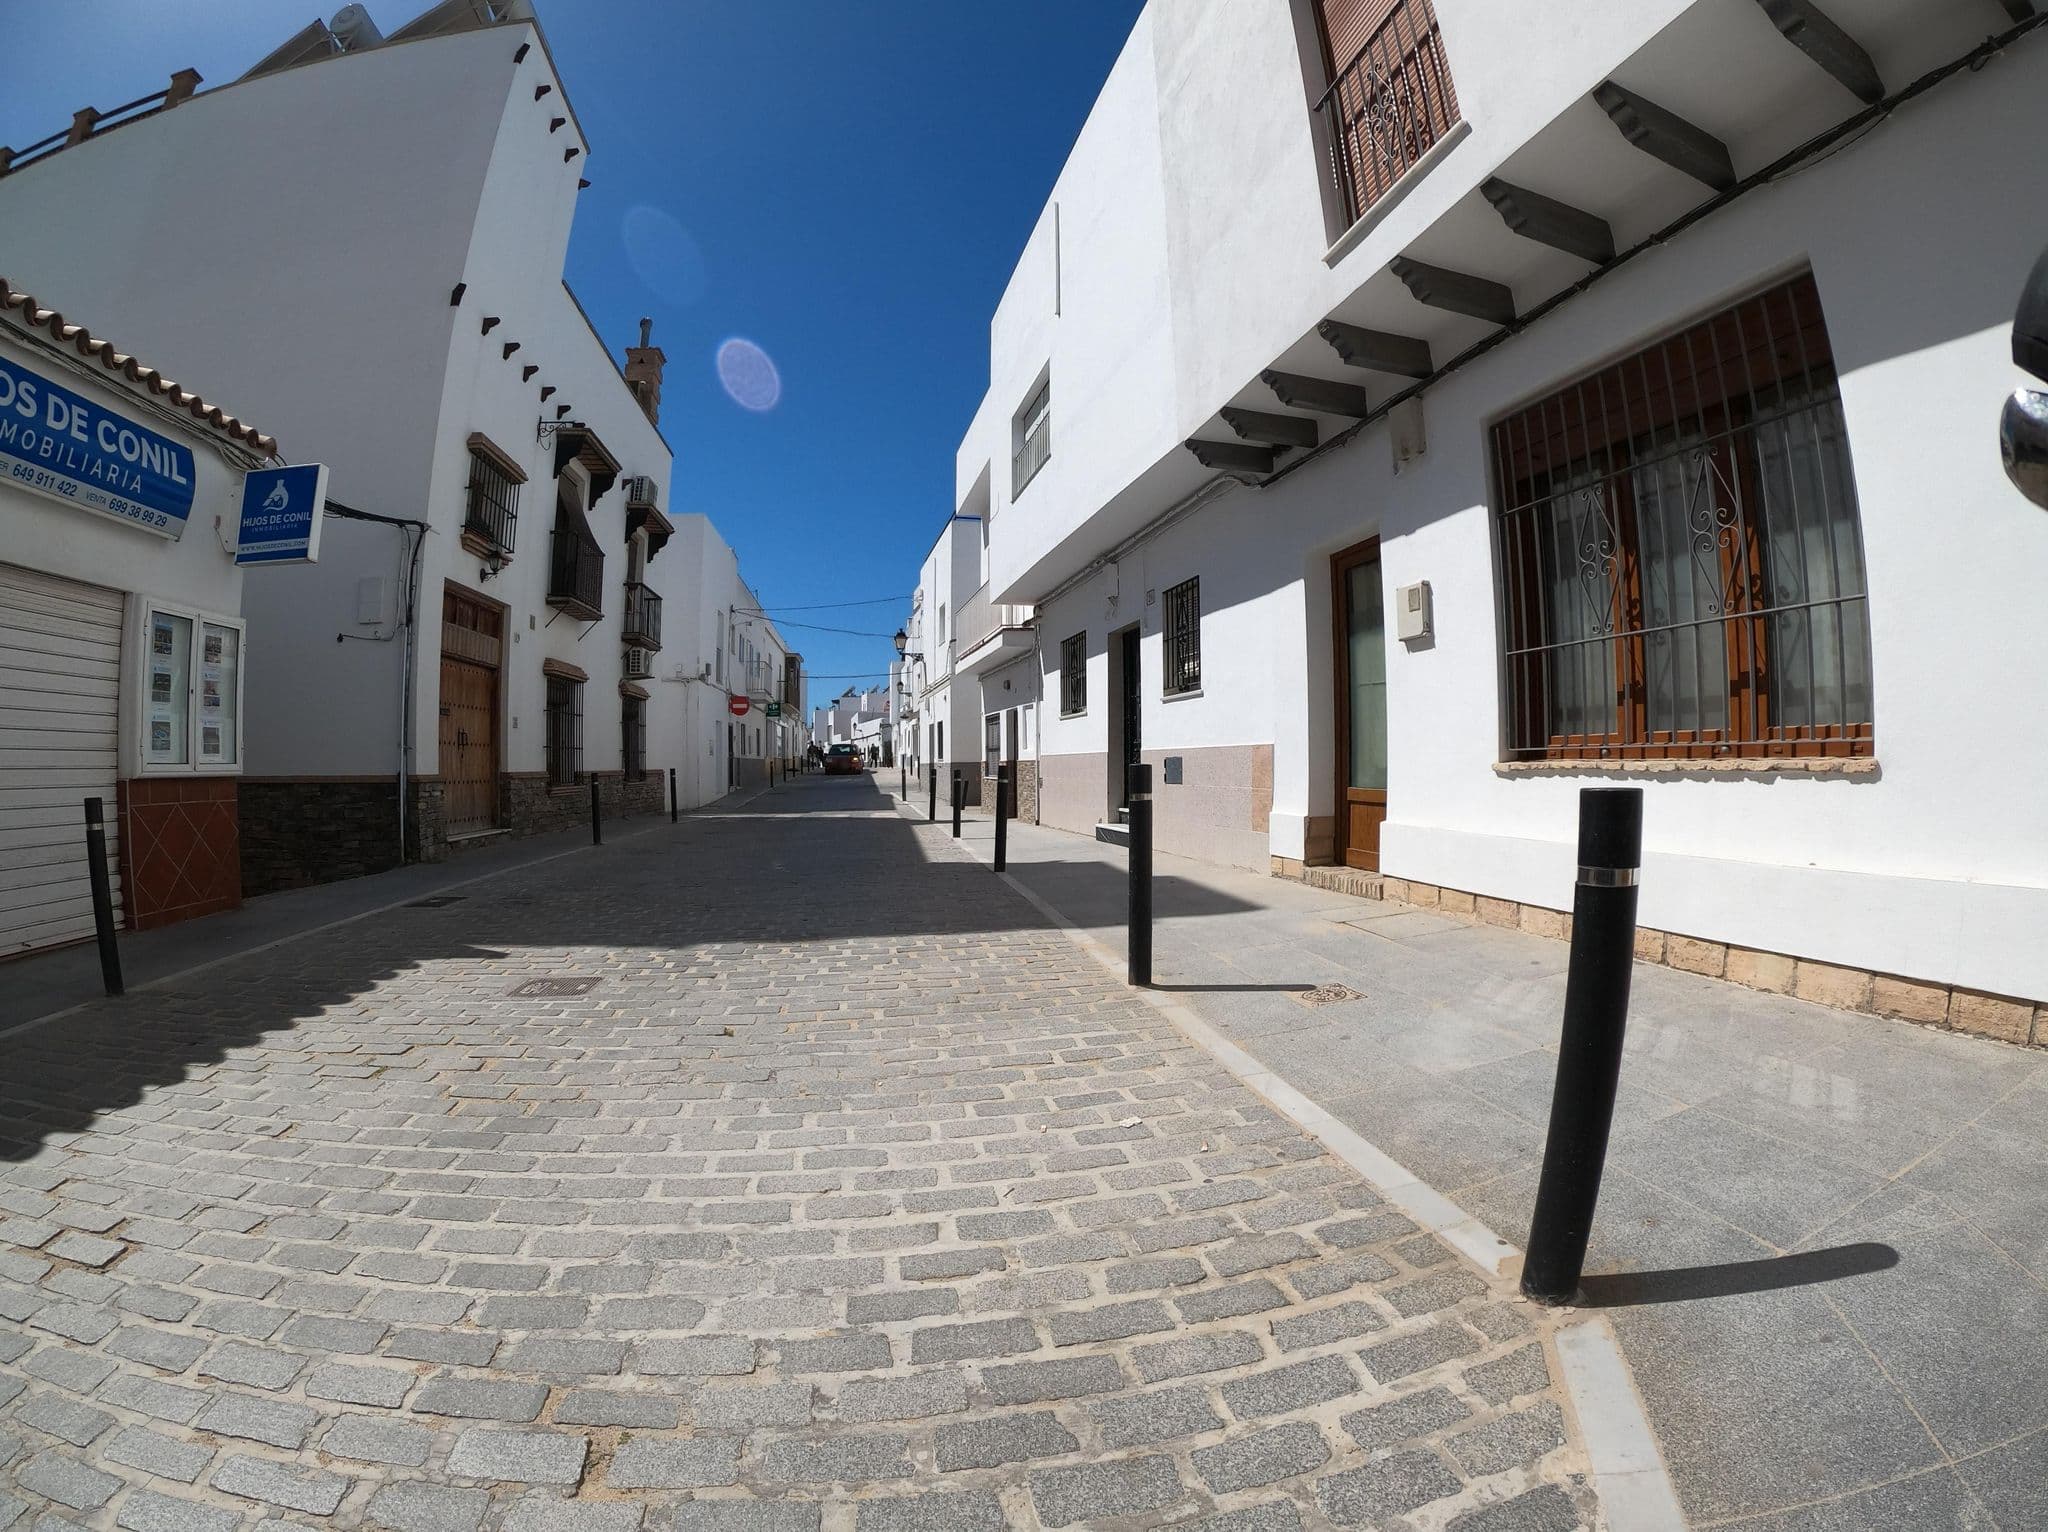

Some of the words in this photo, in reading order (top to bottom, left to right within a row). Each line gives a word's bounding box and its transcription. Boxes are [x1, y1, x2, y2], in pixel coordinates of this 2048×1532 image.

[46, 393, 89, 443] DE
[97, 419, 188, 486] CONIL
[12, 463, 35, 482] 649
[35, 472, 56, 489] 911
[57, 480, 78, 497] 422
[86, 489, 107, 505] VENTA
[109, 497, 128, 514] 699
[128, 505, 141, 519] 38
[141, 510, 155, 523] 99
[154, 515, 168, 528] 29
[242, 515, 269, 528] HIJOS
[269, 514, 282, 524] DE
[283, 511, 311, 523] CONIL
